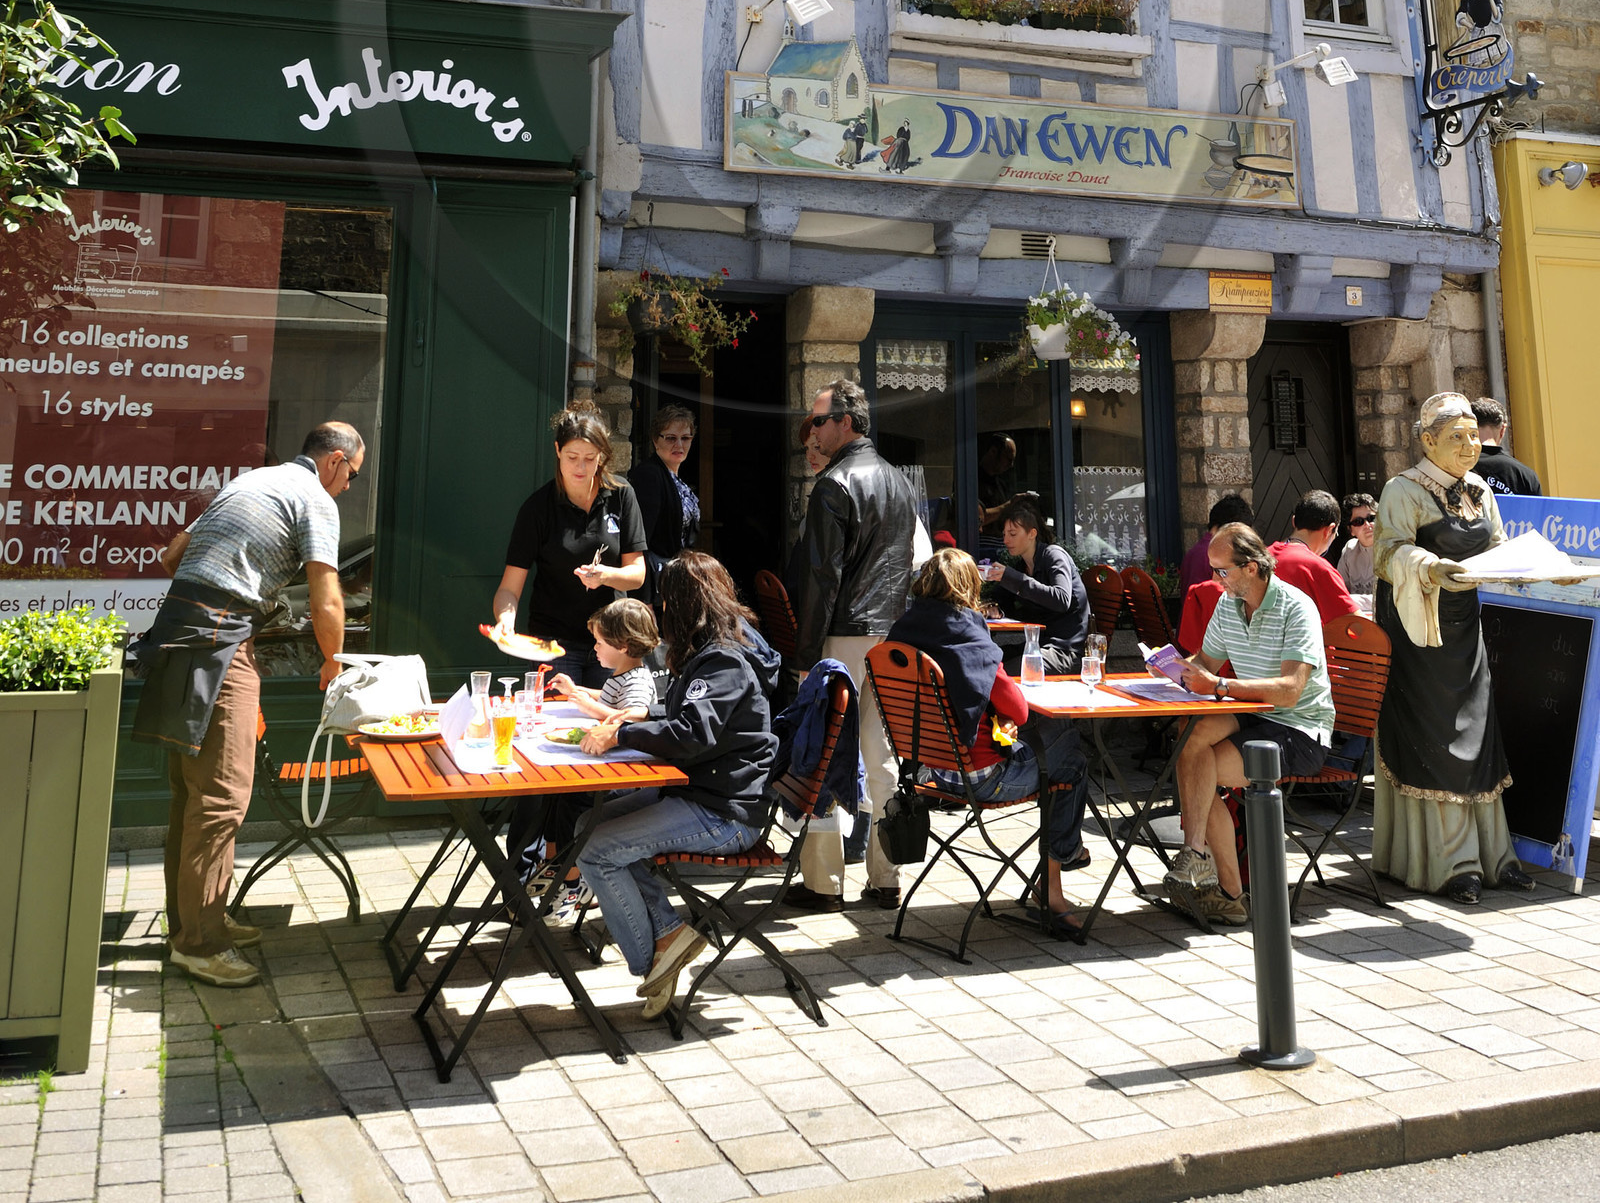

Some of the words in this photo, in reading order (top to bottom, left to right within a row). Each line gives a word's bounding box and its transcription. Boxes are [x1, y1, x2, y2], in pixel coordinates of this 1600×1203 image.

[281, 47, 525, 143] Interior's
[930, 101, 1030, 159] DAN
[1035, 110, 1188, 169] EWEN
[85, 285, 126, 294] Décoration
[127, 287, 159, 297] Canapés
[1351, 292, 1357, 300] 3
[19, 319, 50, 345] 16
[57, 325, 189, 349] collections
[108, 358, 134, 377] et
[141, 359, 245, 385] canapés
[41, 390, 73, 415] 16
[80, 395, 153, 421] styles
[24, 464, 252, 491] COMMERCIA
[0, 500, 22, 526] E
[33, 500, 187, 526] KERLANN
[0, 537, 24, 565] 0
[28, 595, 46, 612] et
